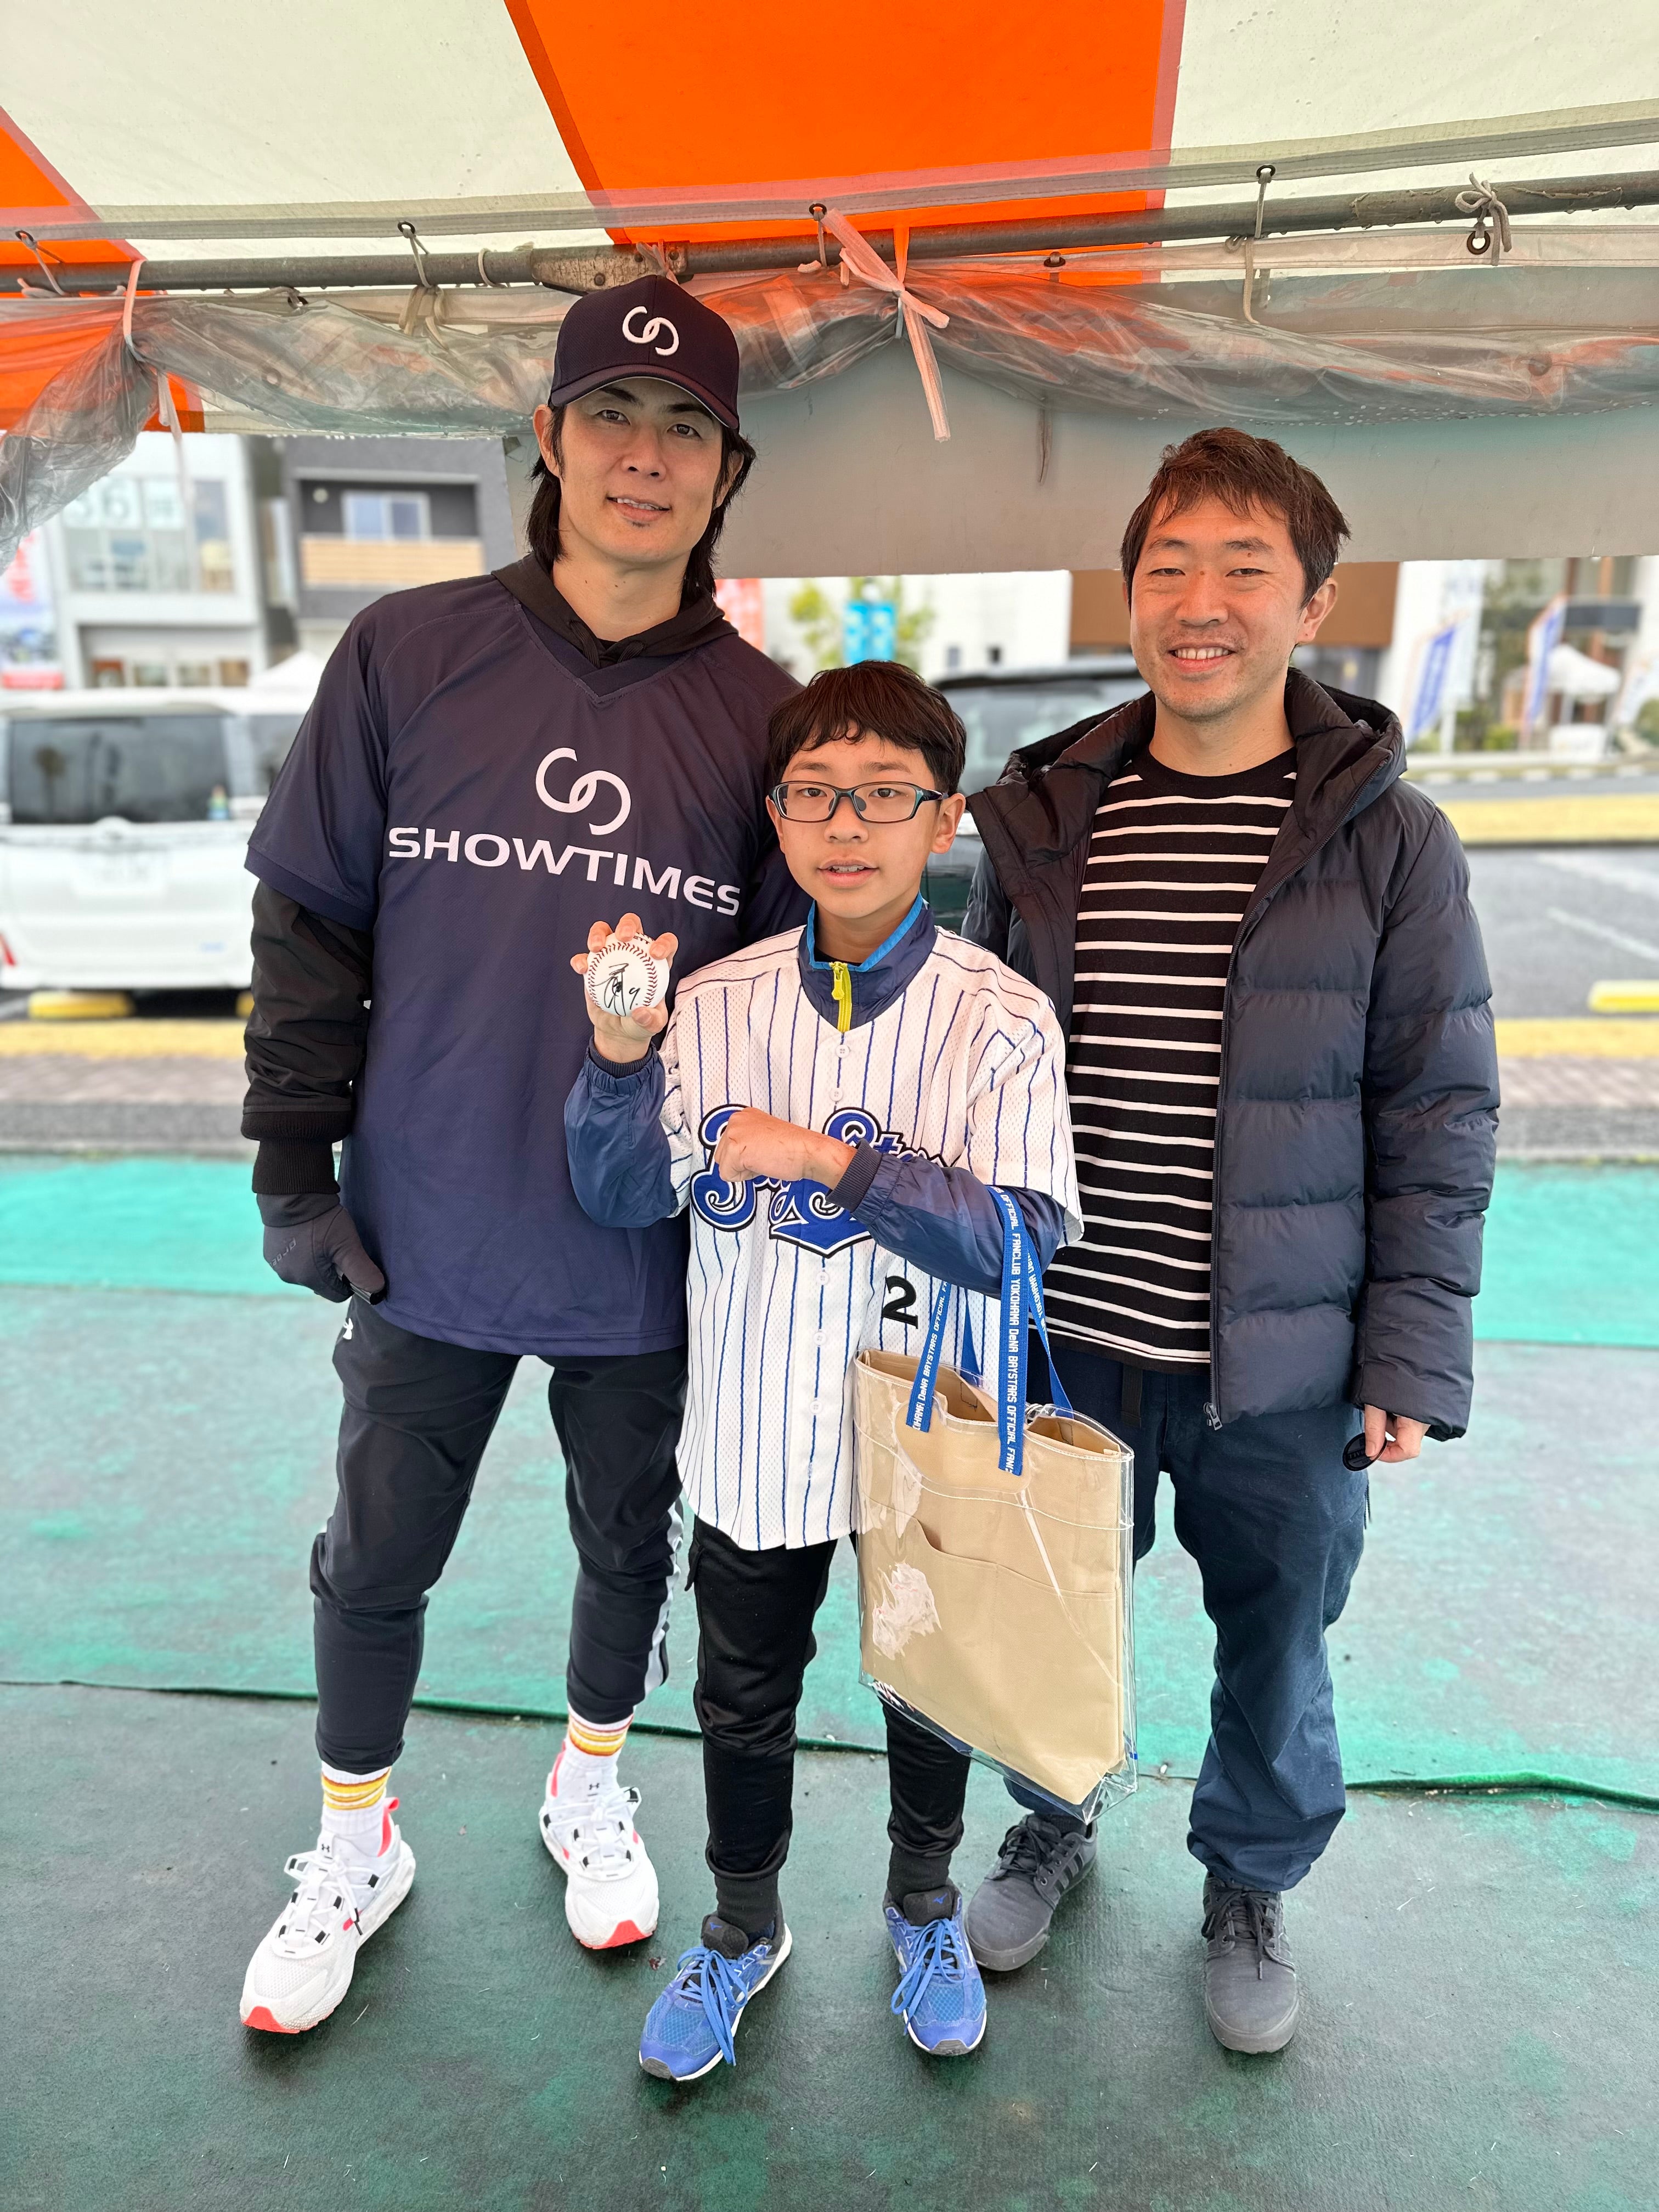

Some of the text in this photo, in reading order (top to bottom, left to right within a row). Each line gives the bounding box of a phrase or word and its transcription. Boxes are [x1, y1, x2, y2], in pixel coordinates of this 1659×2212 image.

[389, 827, 741, 916] SHOWTIMES
[1000, 1194, 1019, 1230] OFFICIAL
[1012, 1233, 1021, 1275] FANCLUB
[881, 1276, 918, 1329] 2
[934, 1295, 945, 1331] OFFICIAL
[1009, 1279, 1021, 1325] YOKOHAMA
[1029, 1274, 1043, 1318] YOKOHAMA
[923, 1333, 938, 1376] BAYSTARS
[1008, 1328, 1019, 1353] DeNA
[918, 1378, 929, 1401] DeNA
[1007, 1356, 1018, 1403] BAYSTARS
[1006, 1406, 1017, 1444] OFFICIAL
